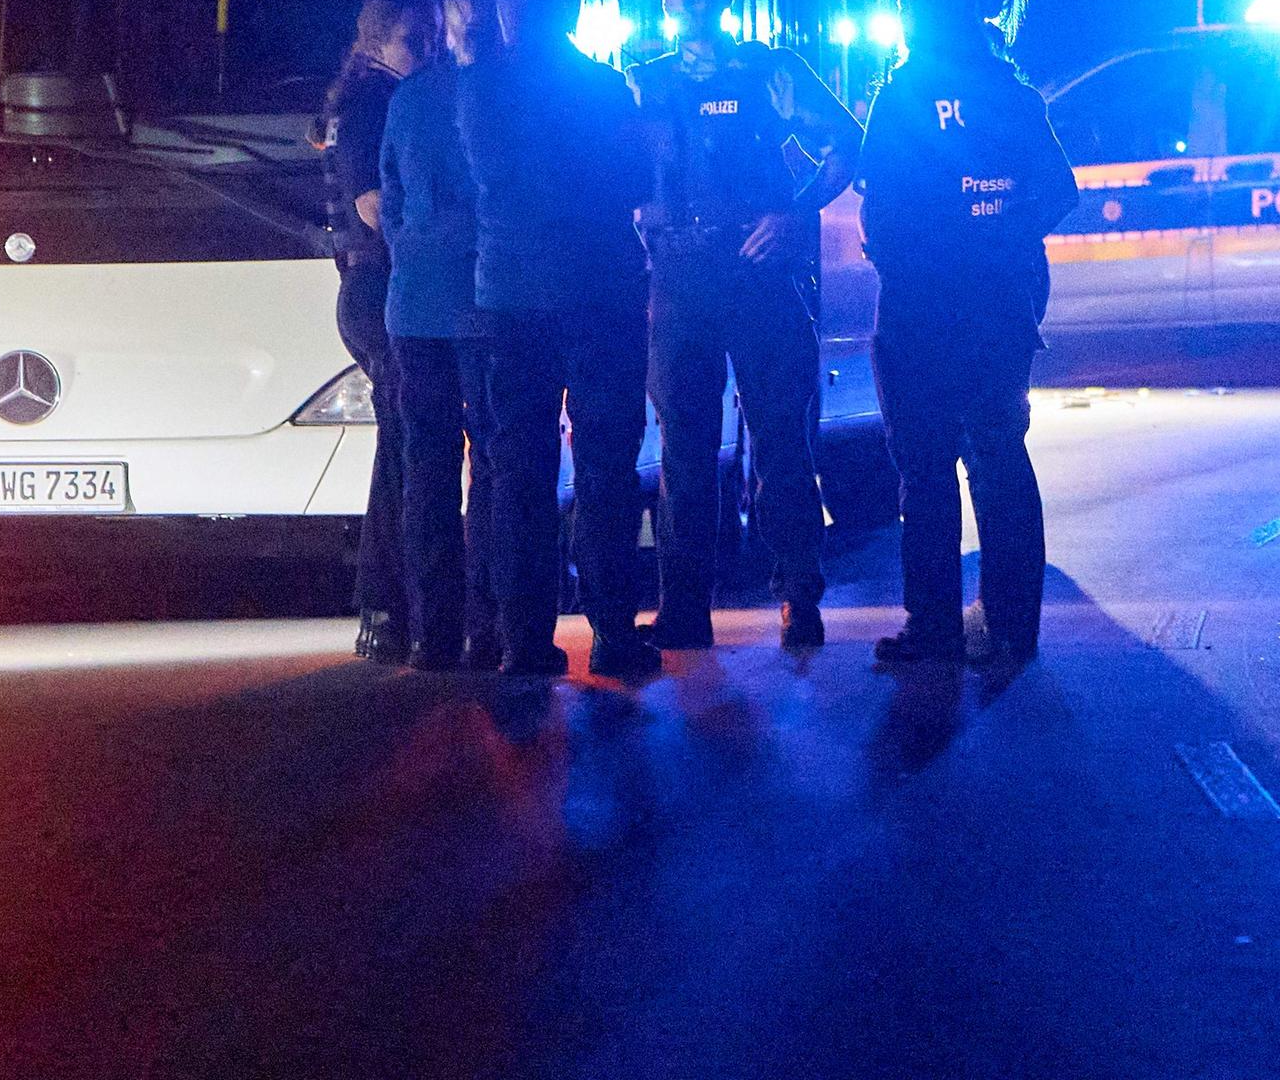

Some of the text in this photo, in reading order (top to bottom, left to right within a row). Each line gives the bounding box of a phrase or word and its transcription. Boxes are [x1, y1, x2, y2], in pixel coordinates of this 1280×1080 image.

[700, 100, 738, 116] POLIZEI
[2, 472, 35, 501] WG
[46, 471, 115, 500] 7334
